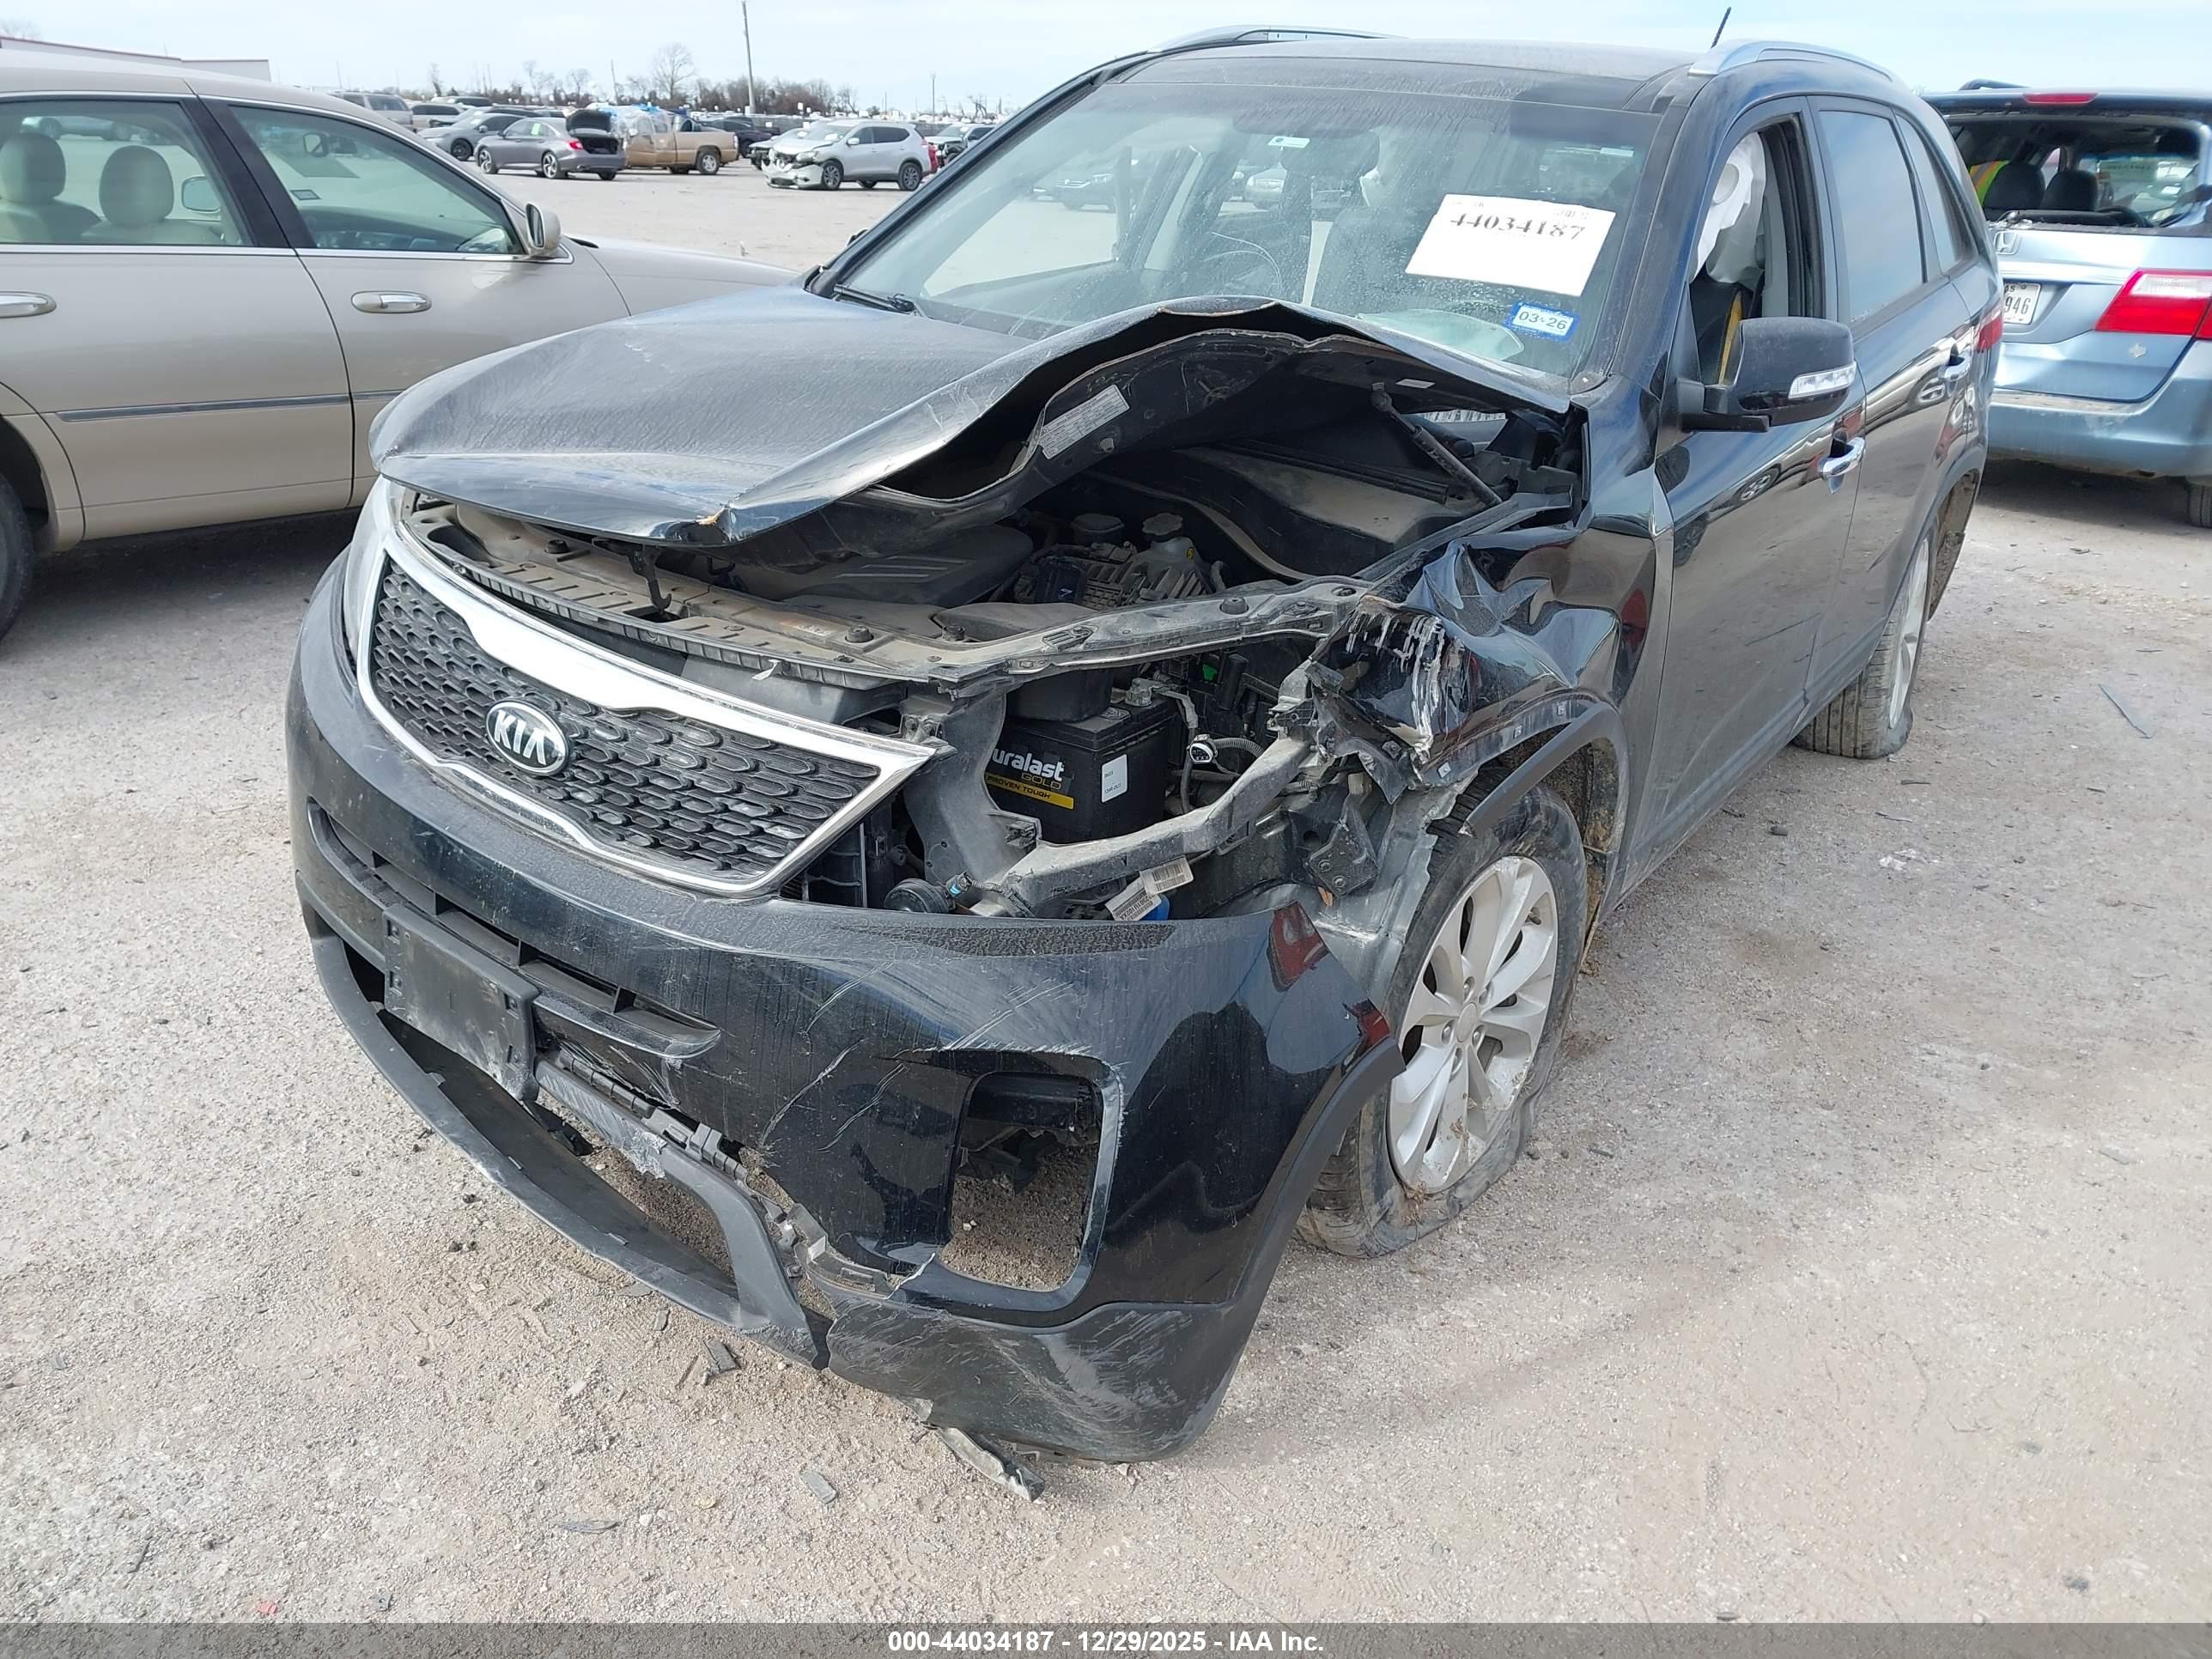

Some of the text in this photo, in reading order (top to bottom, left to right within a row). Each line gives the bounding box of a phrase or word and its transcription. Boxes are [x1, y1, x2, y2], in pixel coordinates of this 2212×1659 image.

[1450, 212, 1586, 240] 44034187
[2004, 295, 2032, 314] 946
[494, 709, 547, 766] KIA
[992, 748, 1065, 782] uralast
[987, 775, 1051, 799] PROVEN TOUGH
[1021, 772, 1062, 790] GOLD
